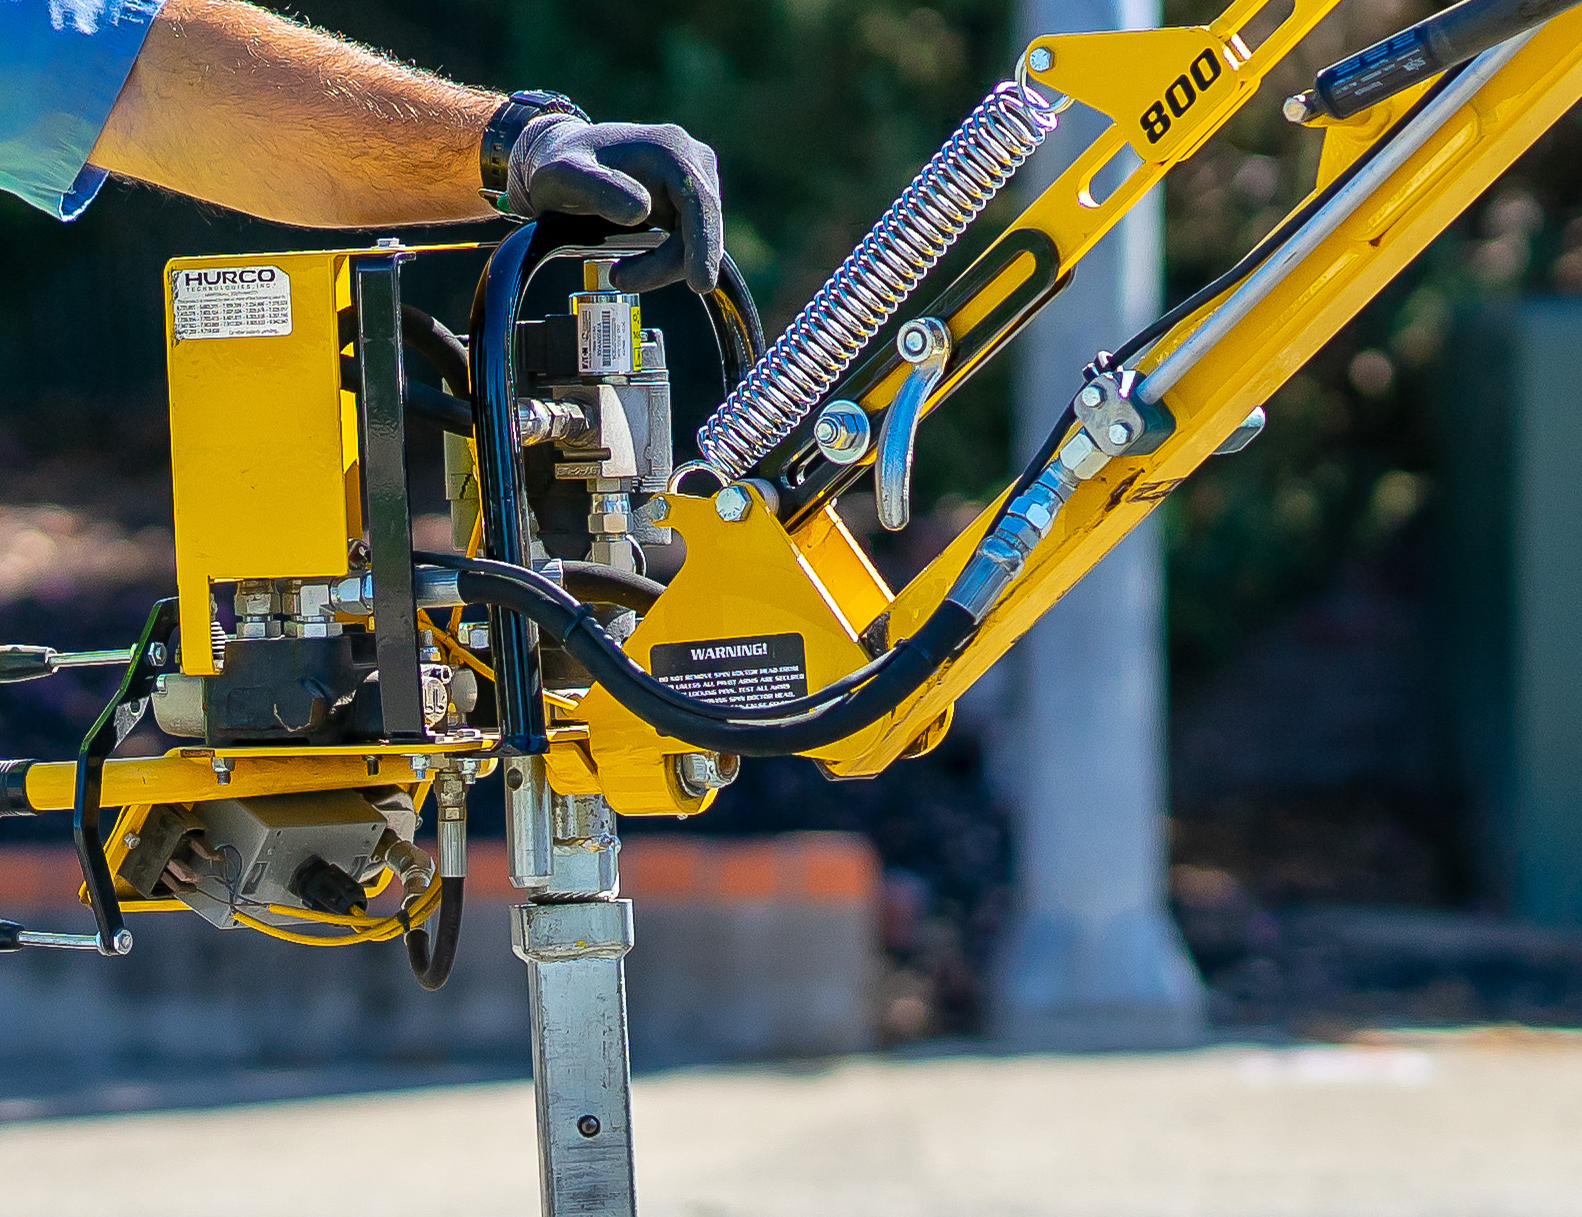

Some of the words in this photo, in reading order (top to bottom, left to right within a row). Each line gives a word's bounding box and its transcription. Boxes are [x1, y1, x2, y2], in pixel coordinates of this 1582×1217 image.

[1138, 48, 1223, 145] 800
[185, 269, 276, 286] HURCO
[691, 643, 768, 661] WARNING!
[685, 673, 713, 681] REMOVE
